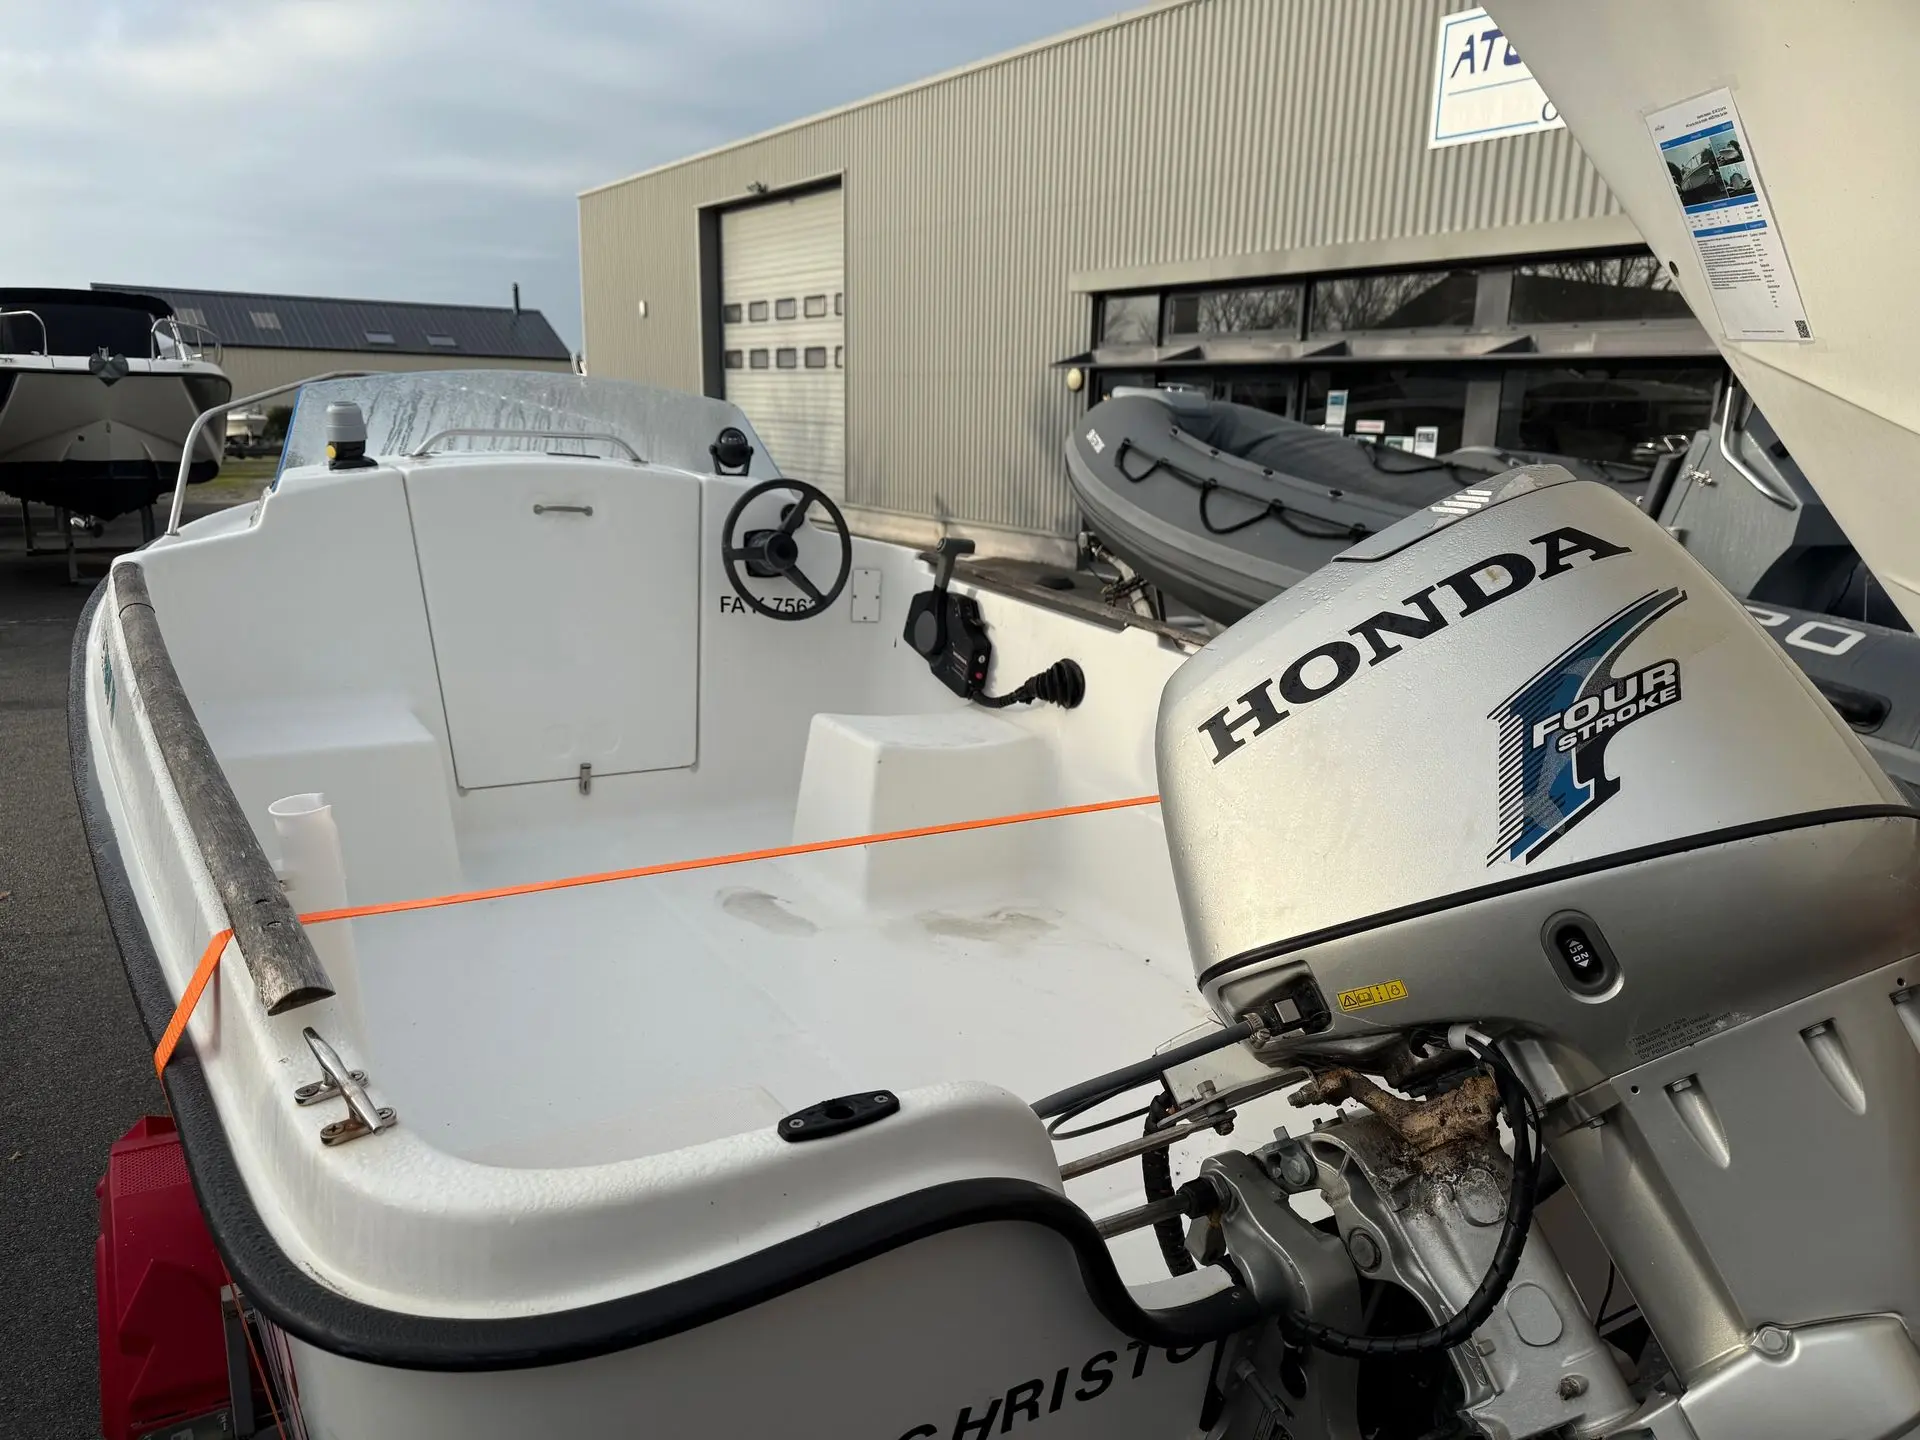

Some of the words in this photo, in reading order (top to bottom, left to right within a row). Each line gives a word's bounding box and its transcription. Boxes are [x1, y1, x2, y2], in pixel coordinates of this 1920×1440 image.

[720, 596, 746, 614] FA
[1198, 527, 1632, 766] HONDA
[1532, 662, 1677, 749] FOUR
[1558, 686, 1677, 752] STROKE
[1570, 945, 1583, 954] UP
